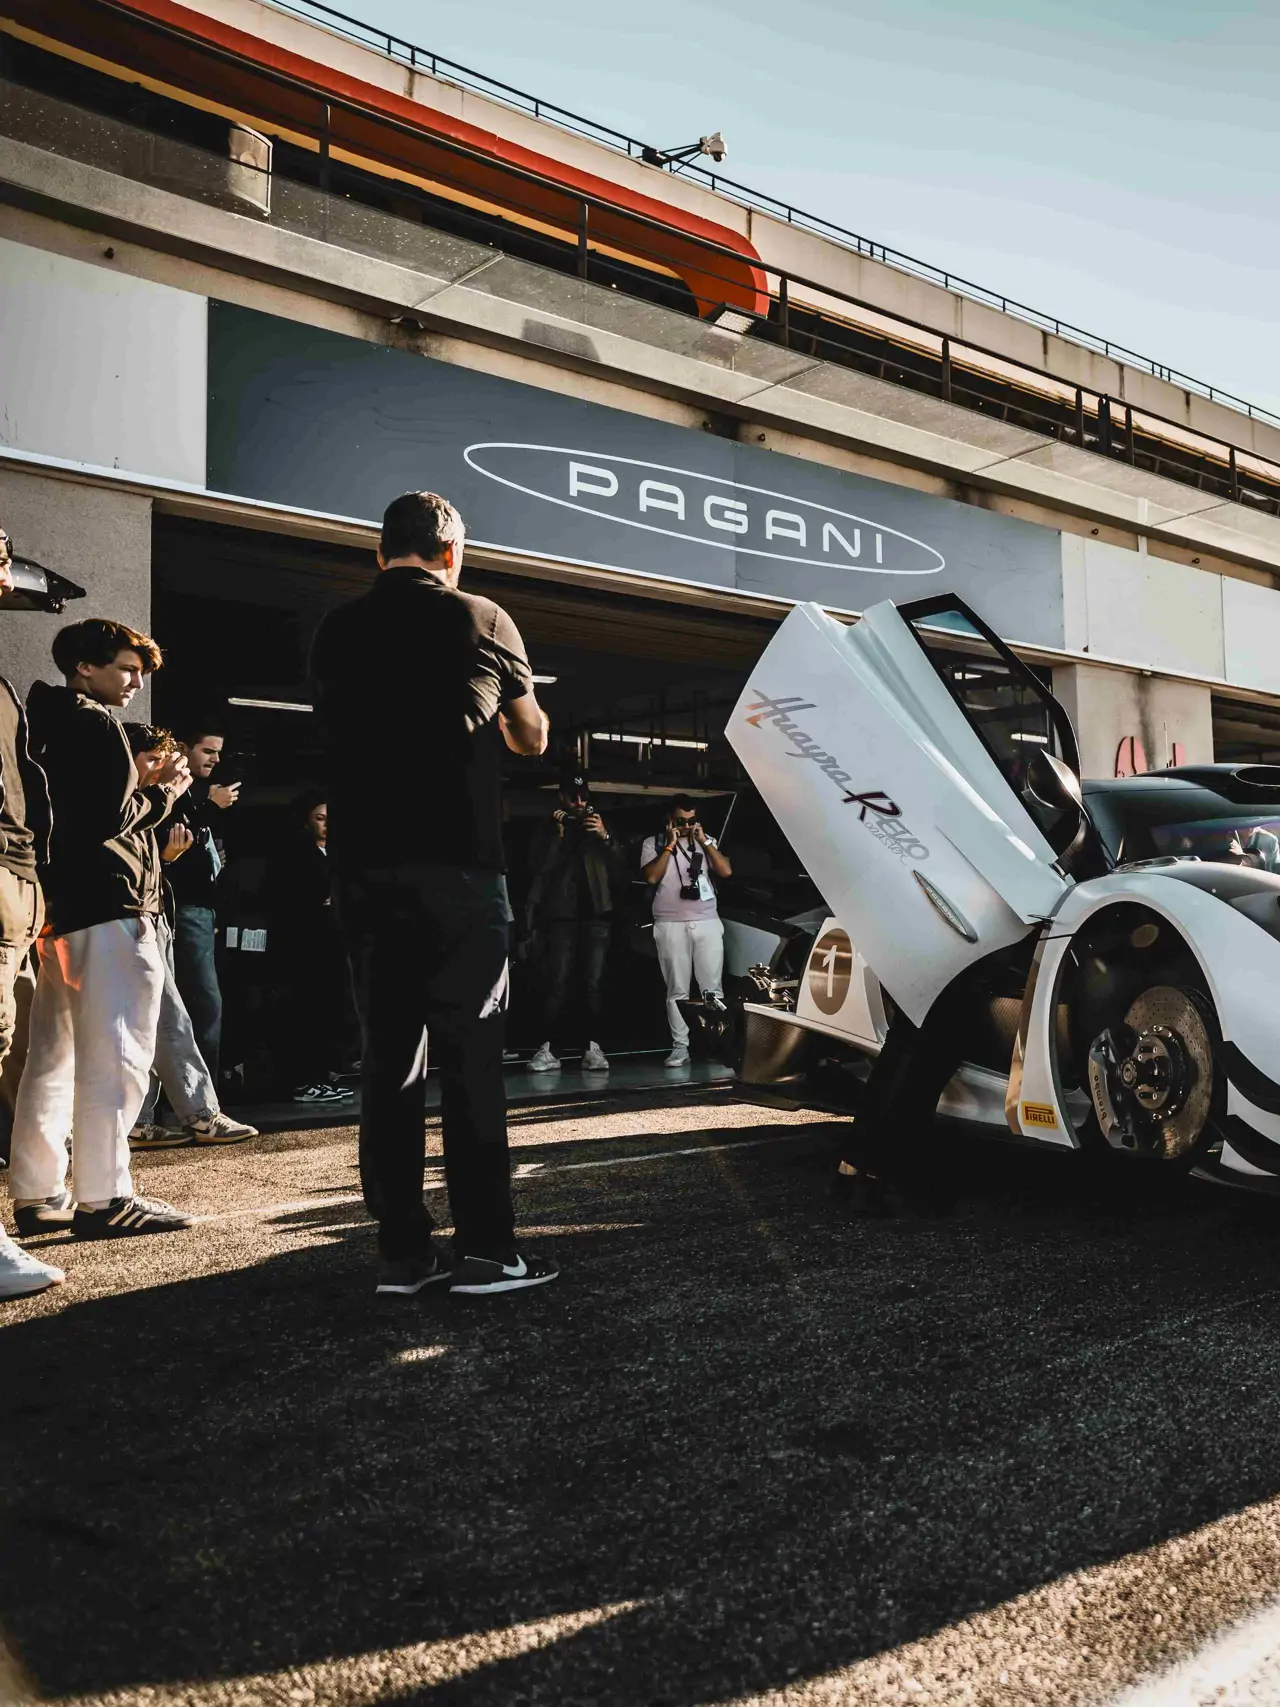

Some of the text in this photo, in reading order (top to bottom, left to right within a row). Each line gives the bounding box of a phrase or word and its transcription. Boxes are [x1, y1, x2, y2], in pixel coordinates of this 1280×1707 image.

[568, 461, 884, 564] PAGANI
[744, 689, 854, 792] Huayra
[822, 944, 838, 998] 1
[1025, 1106, 1055, 1124] PIRELLI
[1094, 1075, 1108, 1120] brembo
